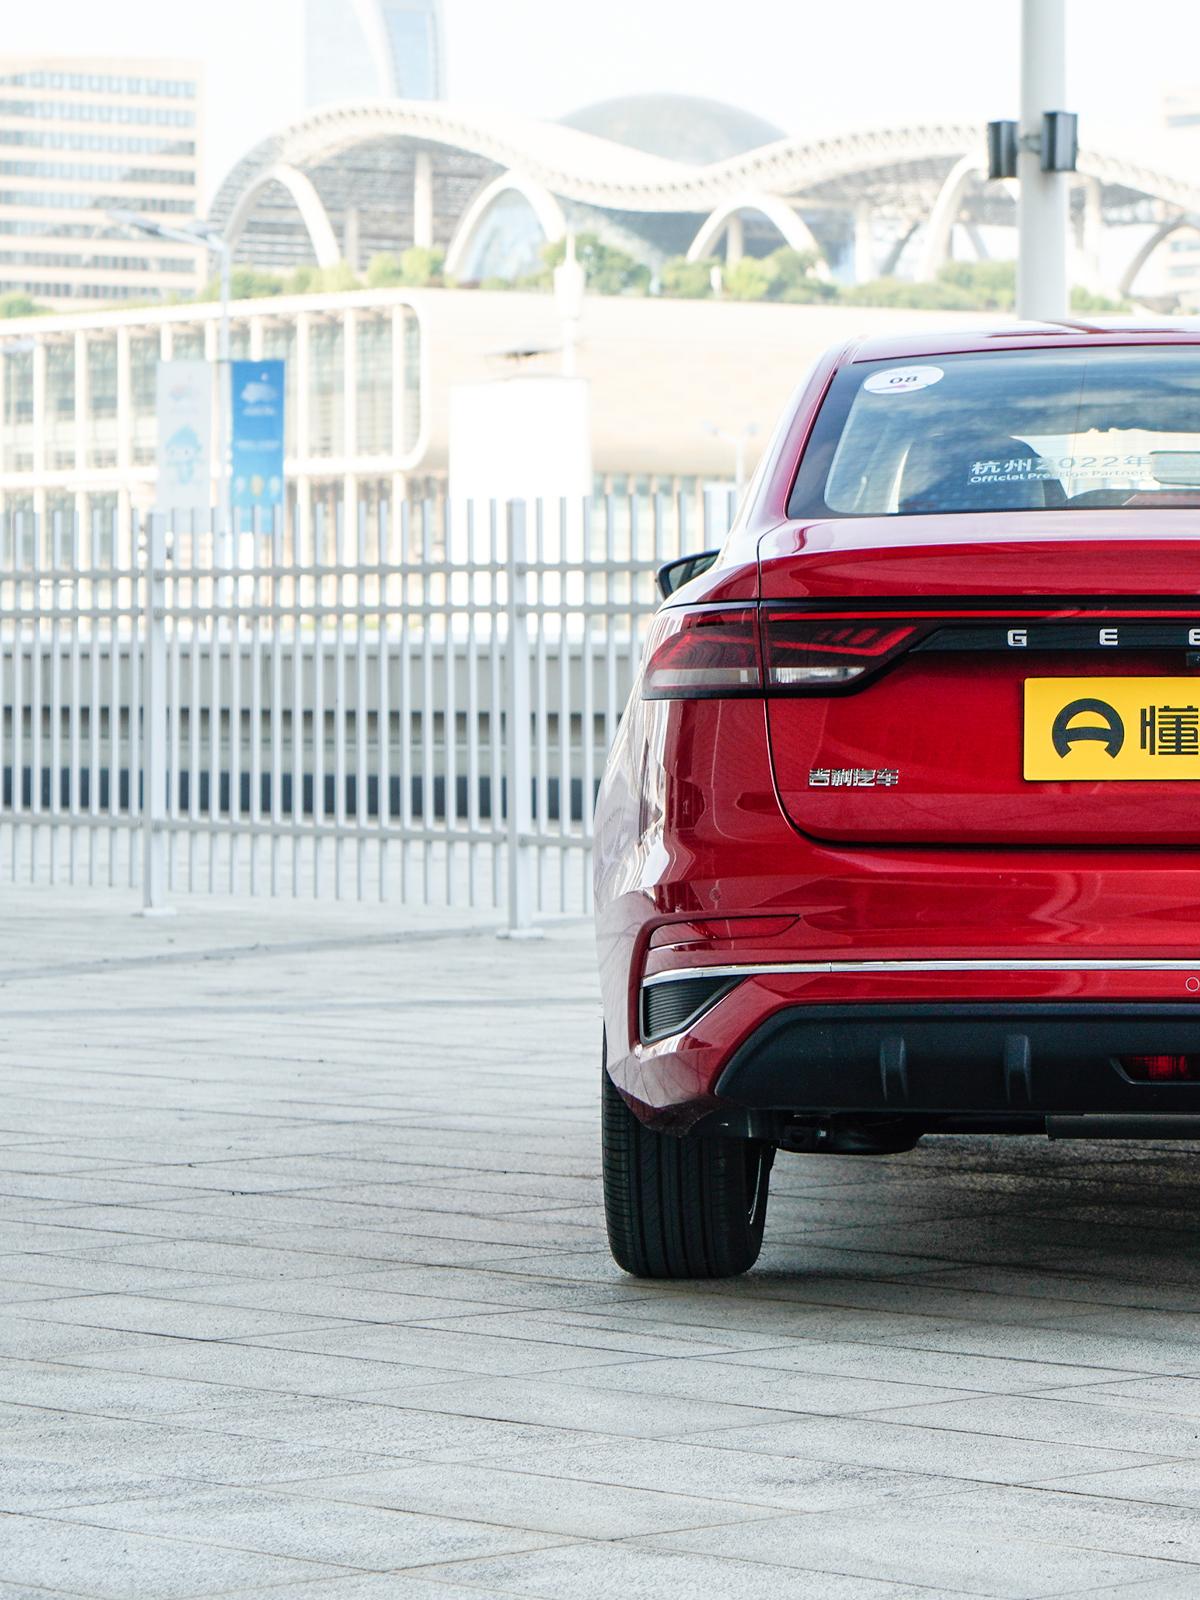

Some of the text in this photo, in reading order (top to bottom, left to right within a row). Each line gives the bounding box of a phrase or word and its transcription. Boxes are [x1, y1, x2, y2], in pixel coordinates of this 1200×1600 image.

[970, 472, 1024, 483] Official
[1028, 471, 1088, 481] Pretige
[809, 768, 899, 787] 吉利汽车
